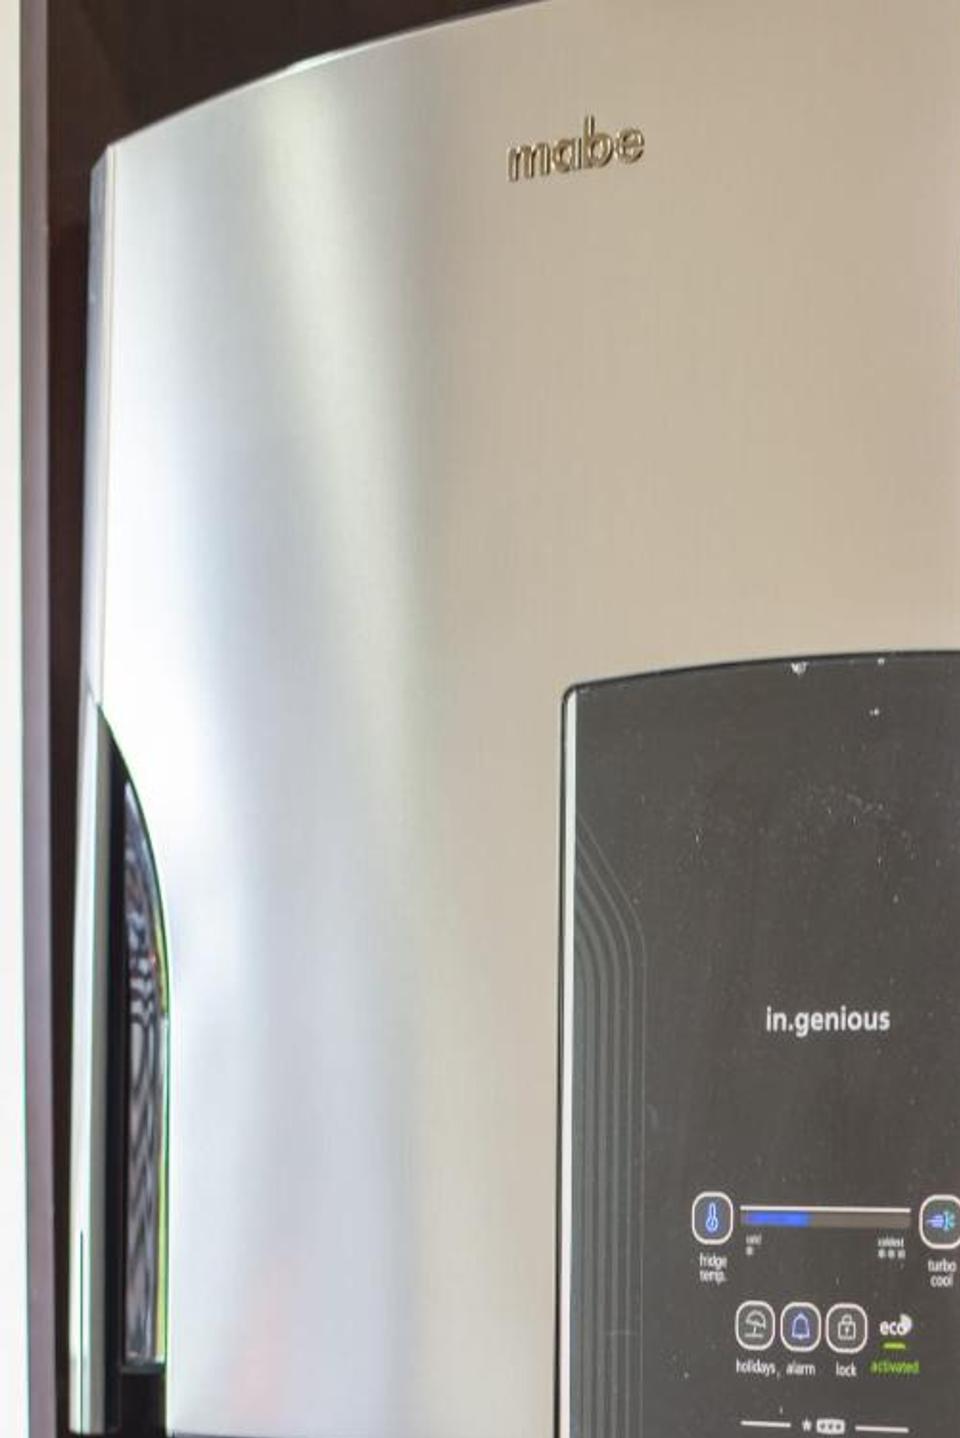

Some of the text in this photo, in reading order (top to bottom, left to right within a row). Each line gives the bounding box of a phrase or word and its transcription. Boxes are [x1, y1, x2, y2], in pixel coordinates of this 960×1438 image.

[508, 114, 645, 182] mabe
[766, 1005, 890, 1038] in.genious
[699, 1252, 728, 1270] fridge
[927, 1258, 957, 1273] turbo
[930, 1272, 953, 1288] cool
[735, 1359, 776, 1377] holidays
[786, 1361, 816, 1376] alarm
[835, 1360, 857, 1377] lock
